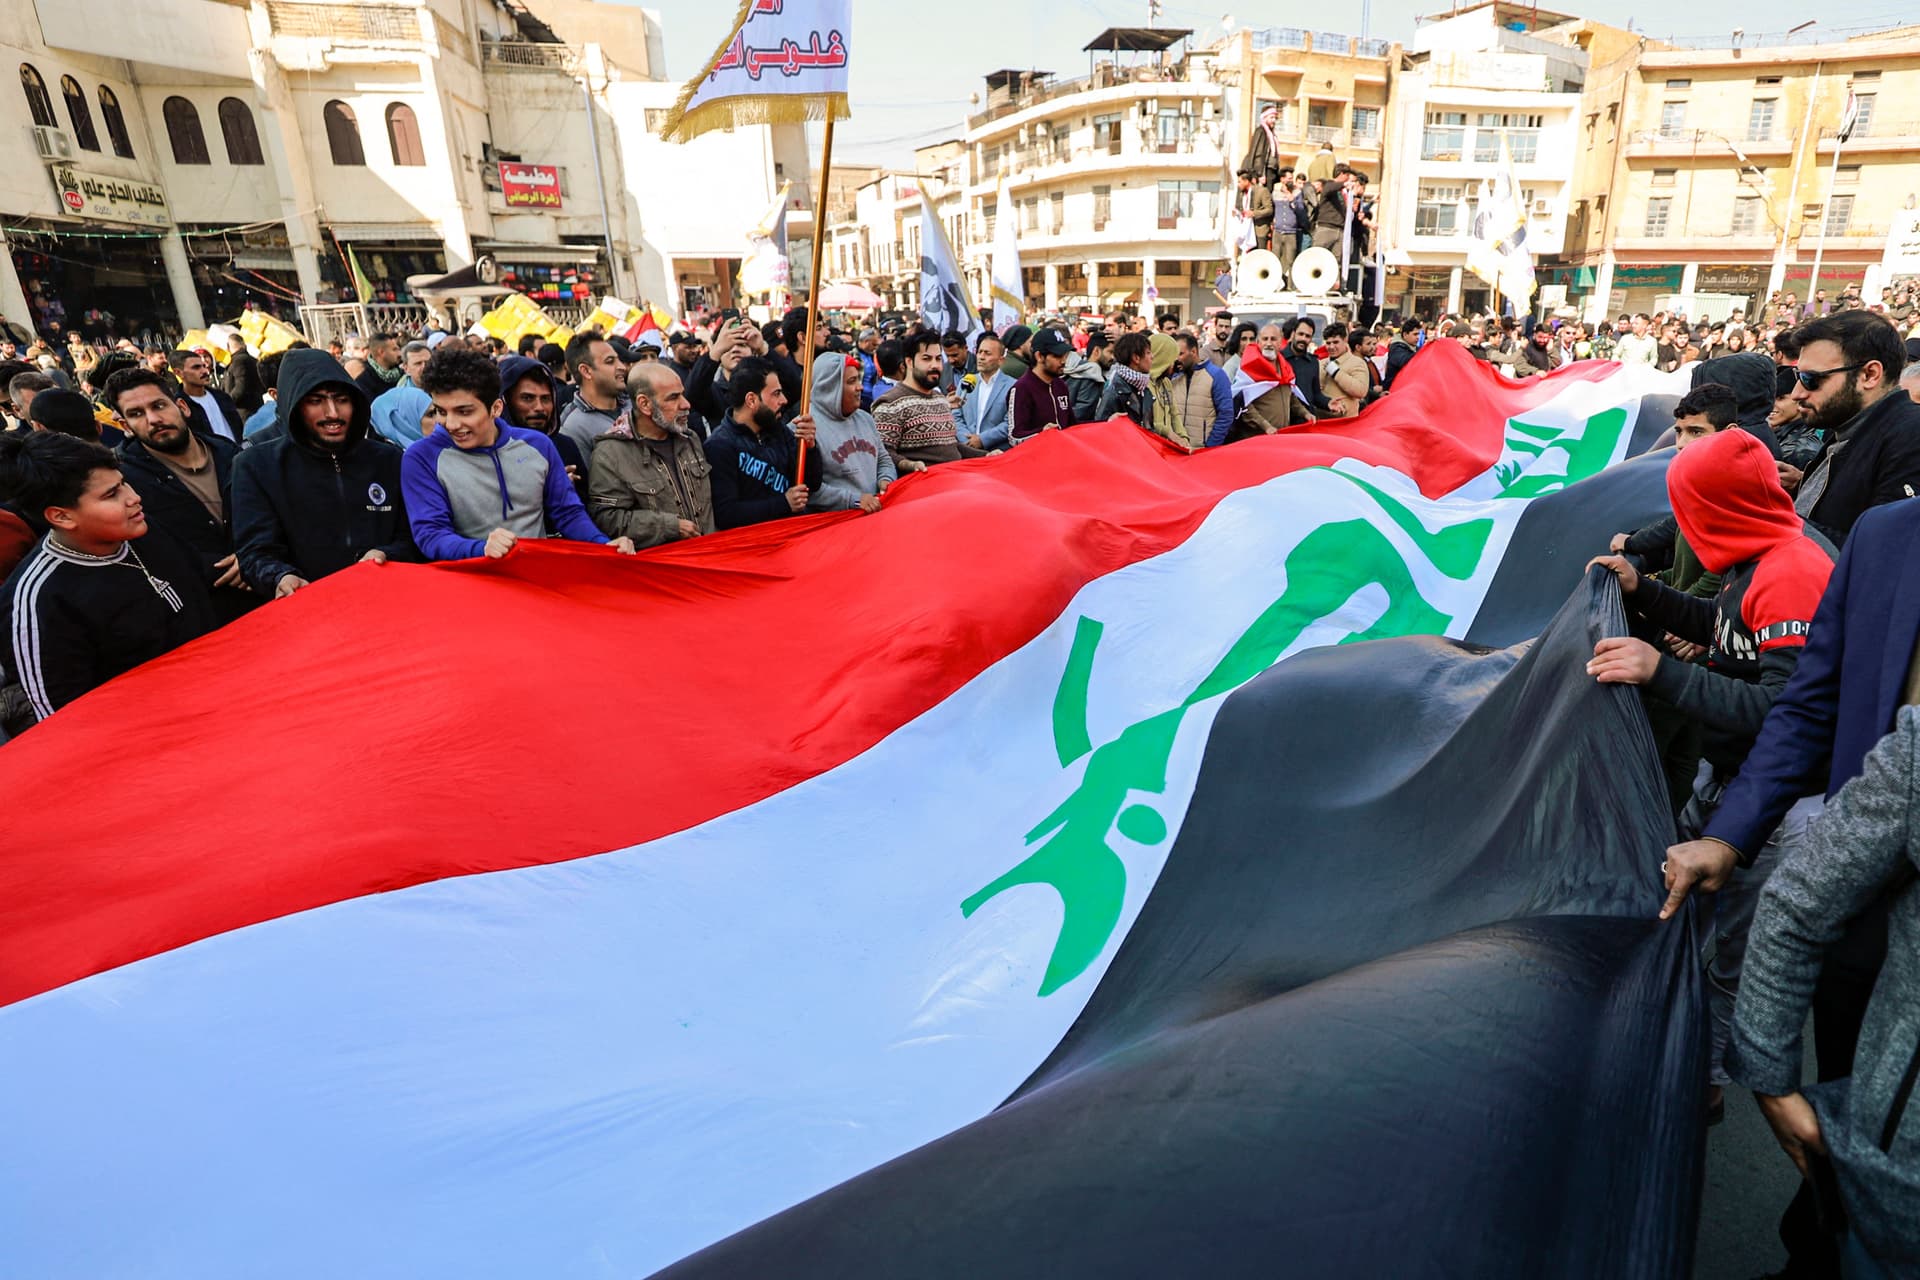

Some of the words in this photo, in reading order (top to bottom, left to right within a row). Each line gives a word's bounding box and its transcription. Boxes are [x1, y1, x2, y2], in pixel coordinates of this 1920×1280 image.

[503, 165, 555, 188] مطبعة
[80, 178, 106, 200] علي
[106, 181, 133, 204] الحاج
[132, 186, 165, 208] حقائب
[1721, 271, 1760, 287] قرطاسية
